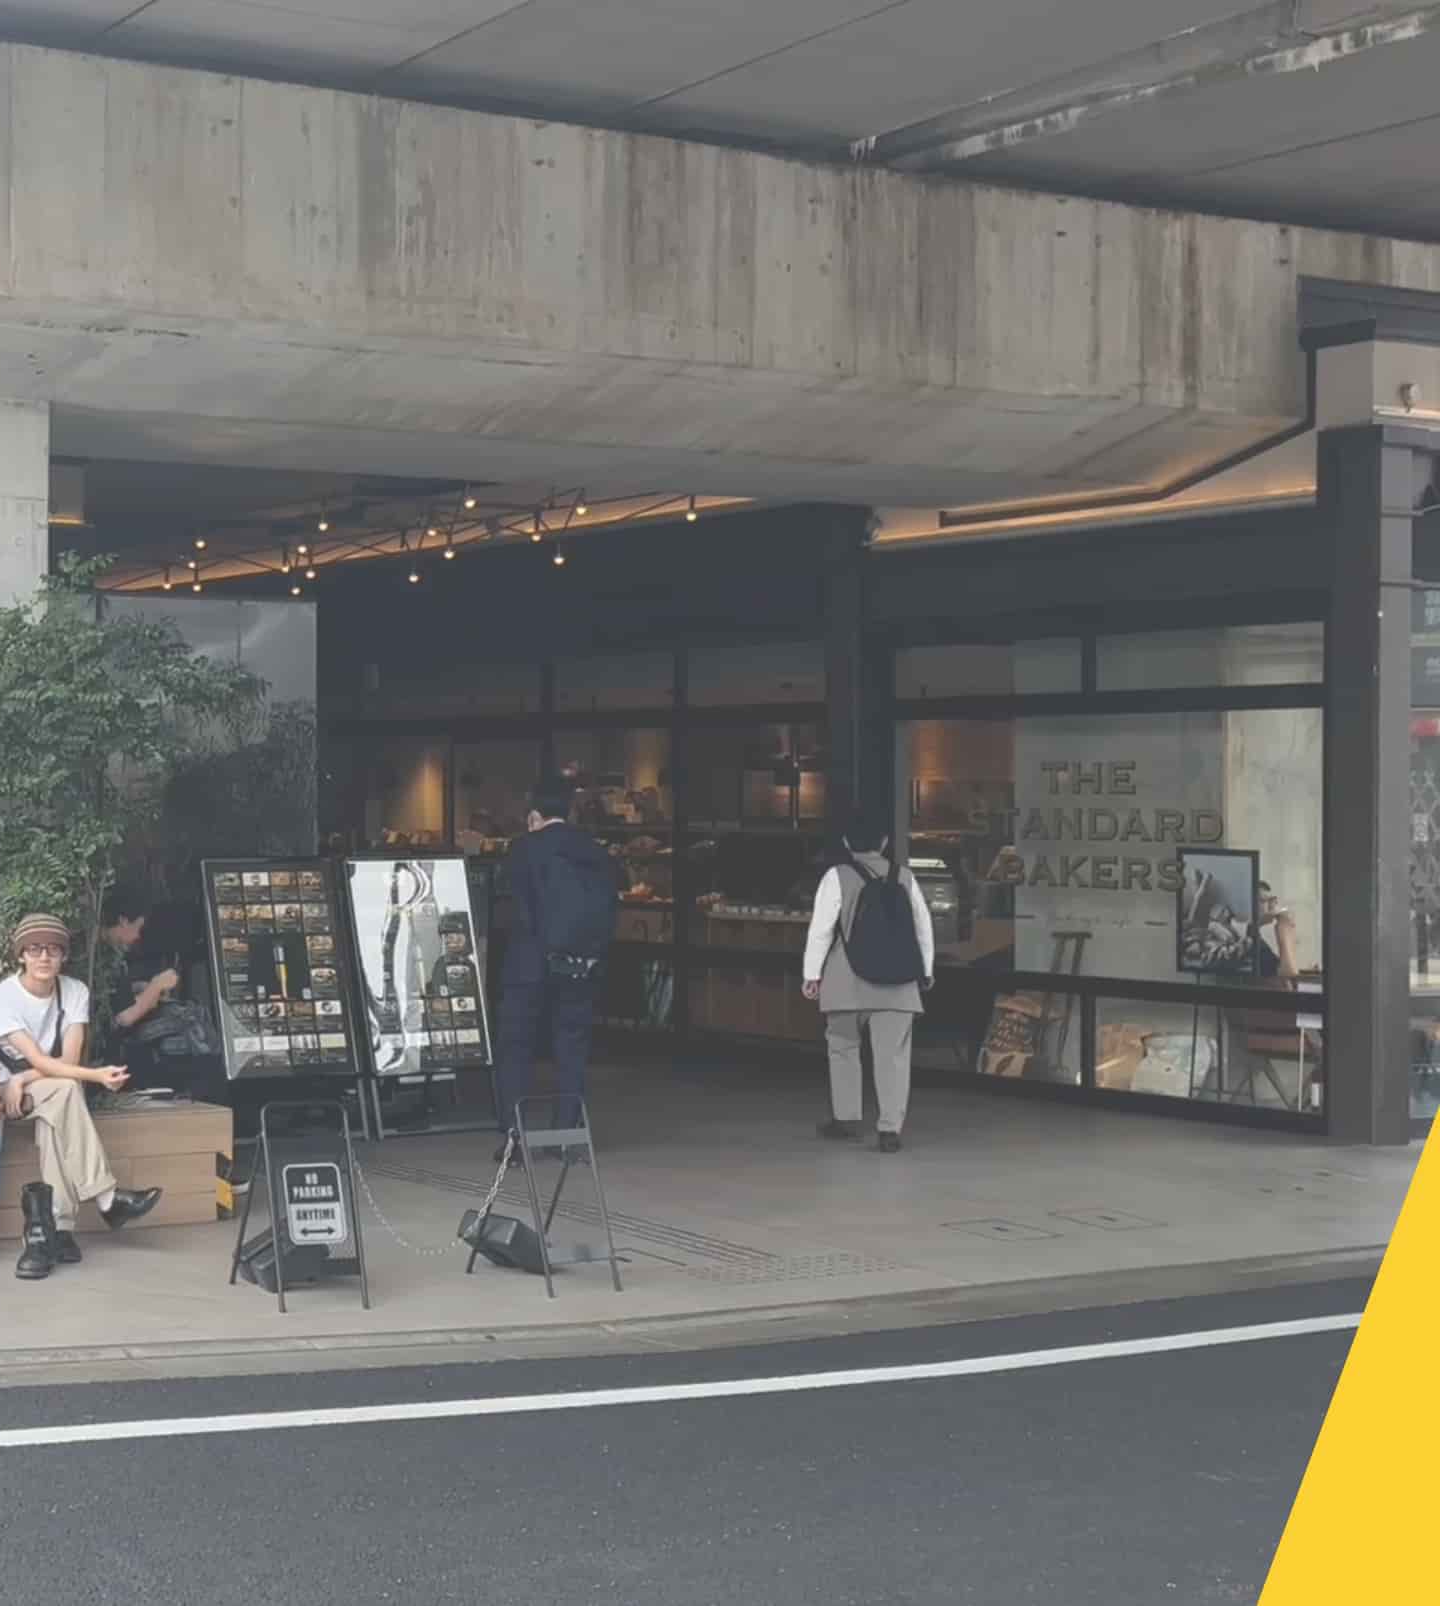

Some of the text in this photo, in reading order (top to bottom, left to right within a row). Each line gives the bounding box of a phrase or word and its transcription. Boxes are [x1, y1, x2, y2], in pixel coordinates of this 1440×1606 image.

[1040, 760, 1137, 796] THE
[304, 1172, 319, 1185] NO
[292, 1185, 334, 1199] PARKING
[296, 1207, 336, 1221] ANYTIME
